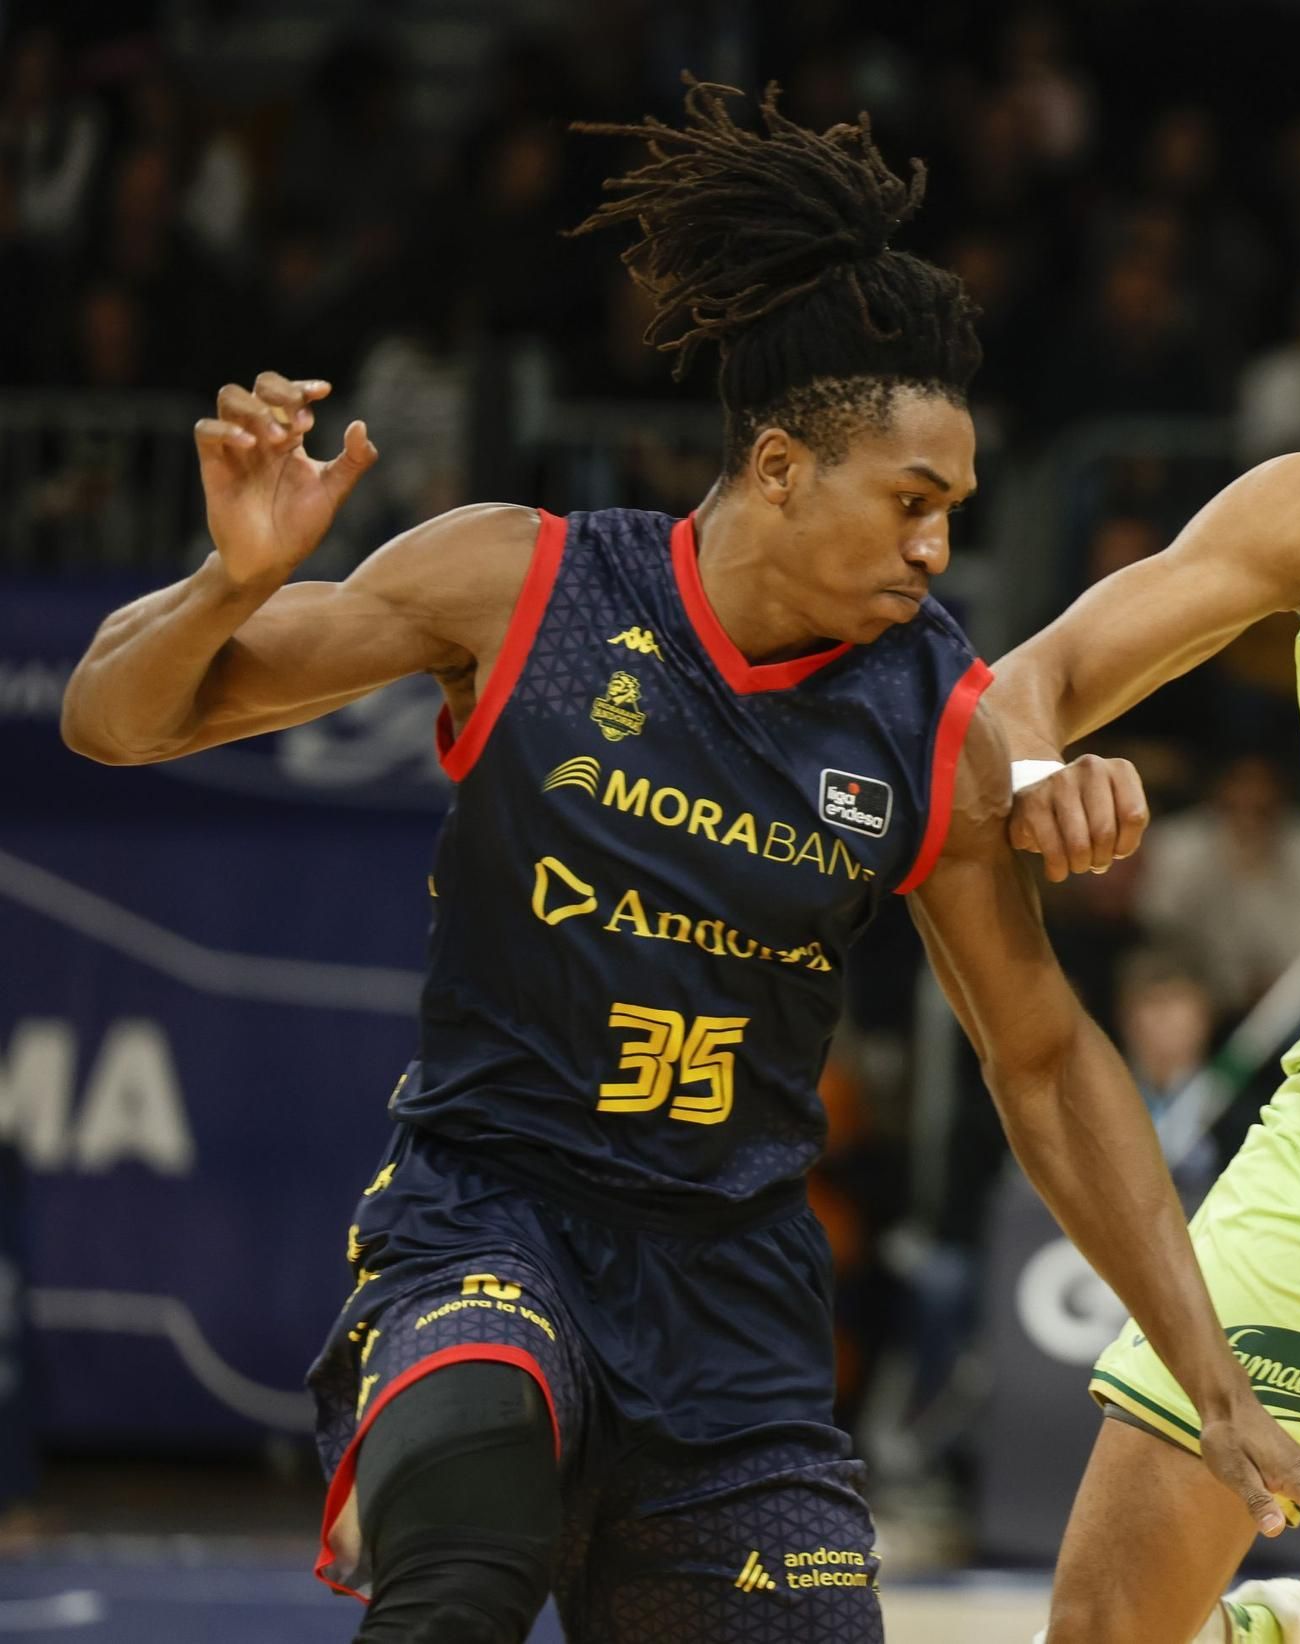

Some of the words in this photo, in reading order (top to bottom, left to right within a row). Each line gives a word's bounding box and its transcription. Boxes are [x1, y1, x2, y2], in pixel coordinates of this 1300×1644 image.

[826, 786, 856, 805] liga
[825, 803, 883, 829] endesa
[596, 1002, 751, 1125] 35
[415, 1299, 492, 1331] Andorra
[496, 1301, 517, 1314] la
[784, 1547, 866, 1568] andorra
[786, 1569, 869, 1590] telecom
